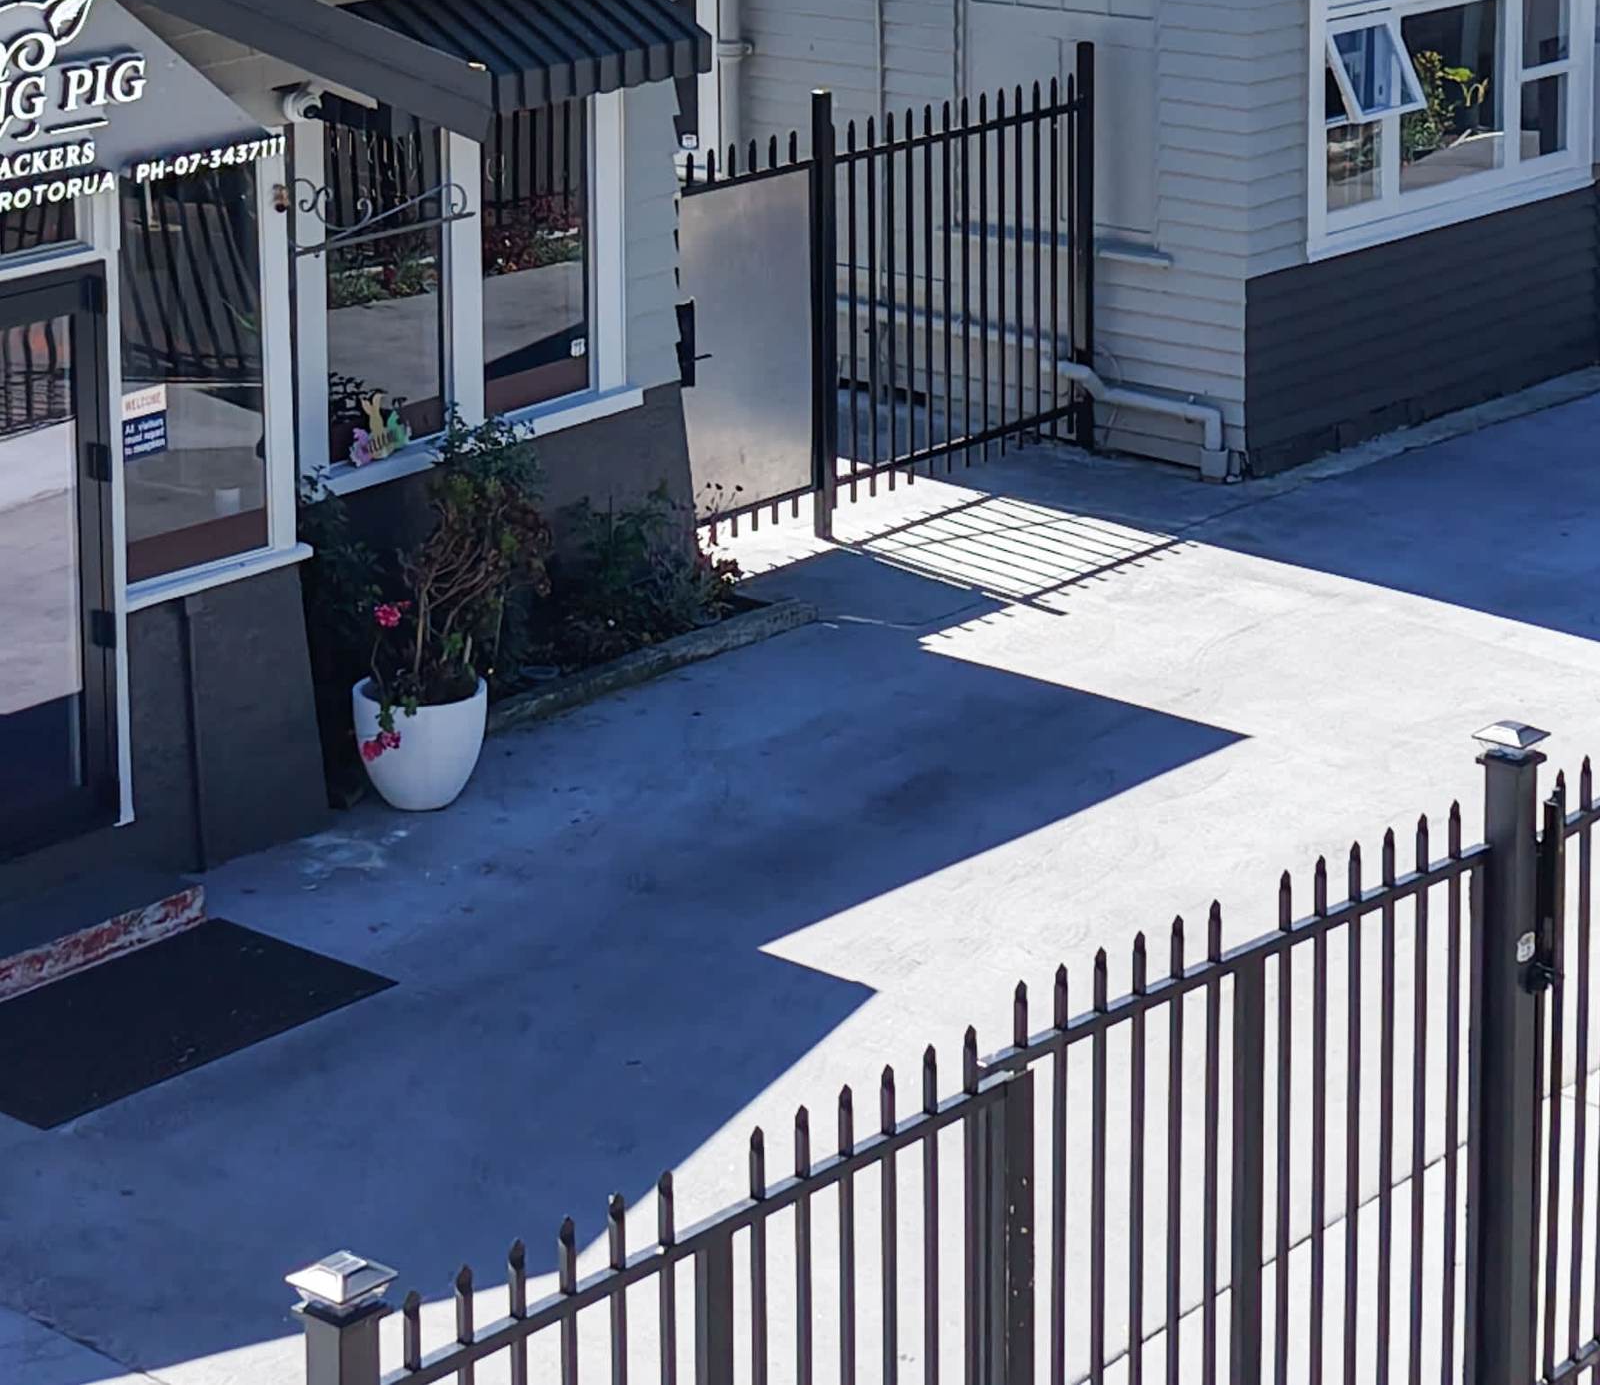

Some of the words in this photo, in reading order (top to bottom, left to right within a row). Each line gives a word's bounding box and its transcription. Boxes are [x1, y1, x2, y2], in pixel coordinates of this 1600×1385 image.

[64, 60, 147, 111] PIG
[0, 141, 95, 180] ACKERS
[0, 172, 115, 213] ROTORUA
[136, 136, 286, 184] PH-07-3437111
